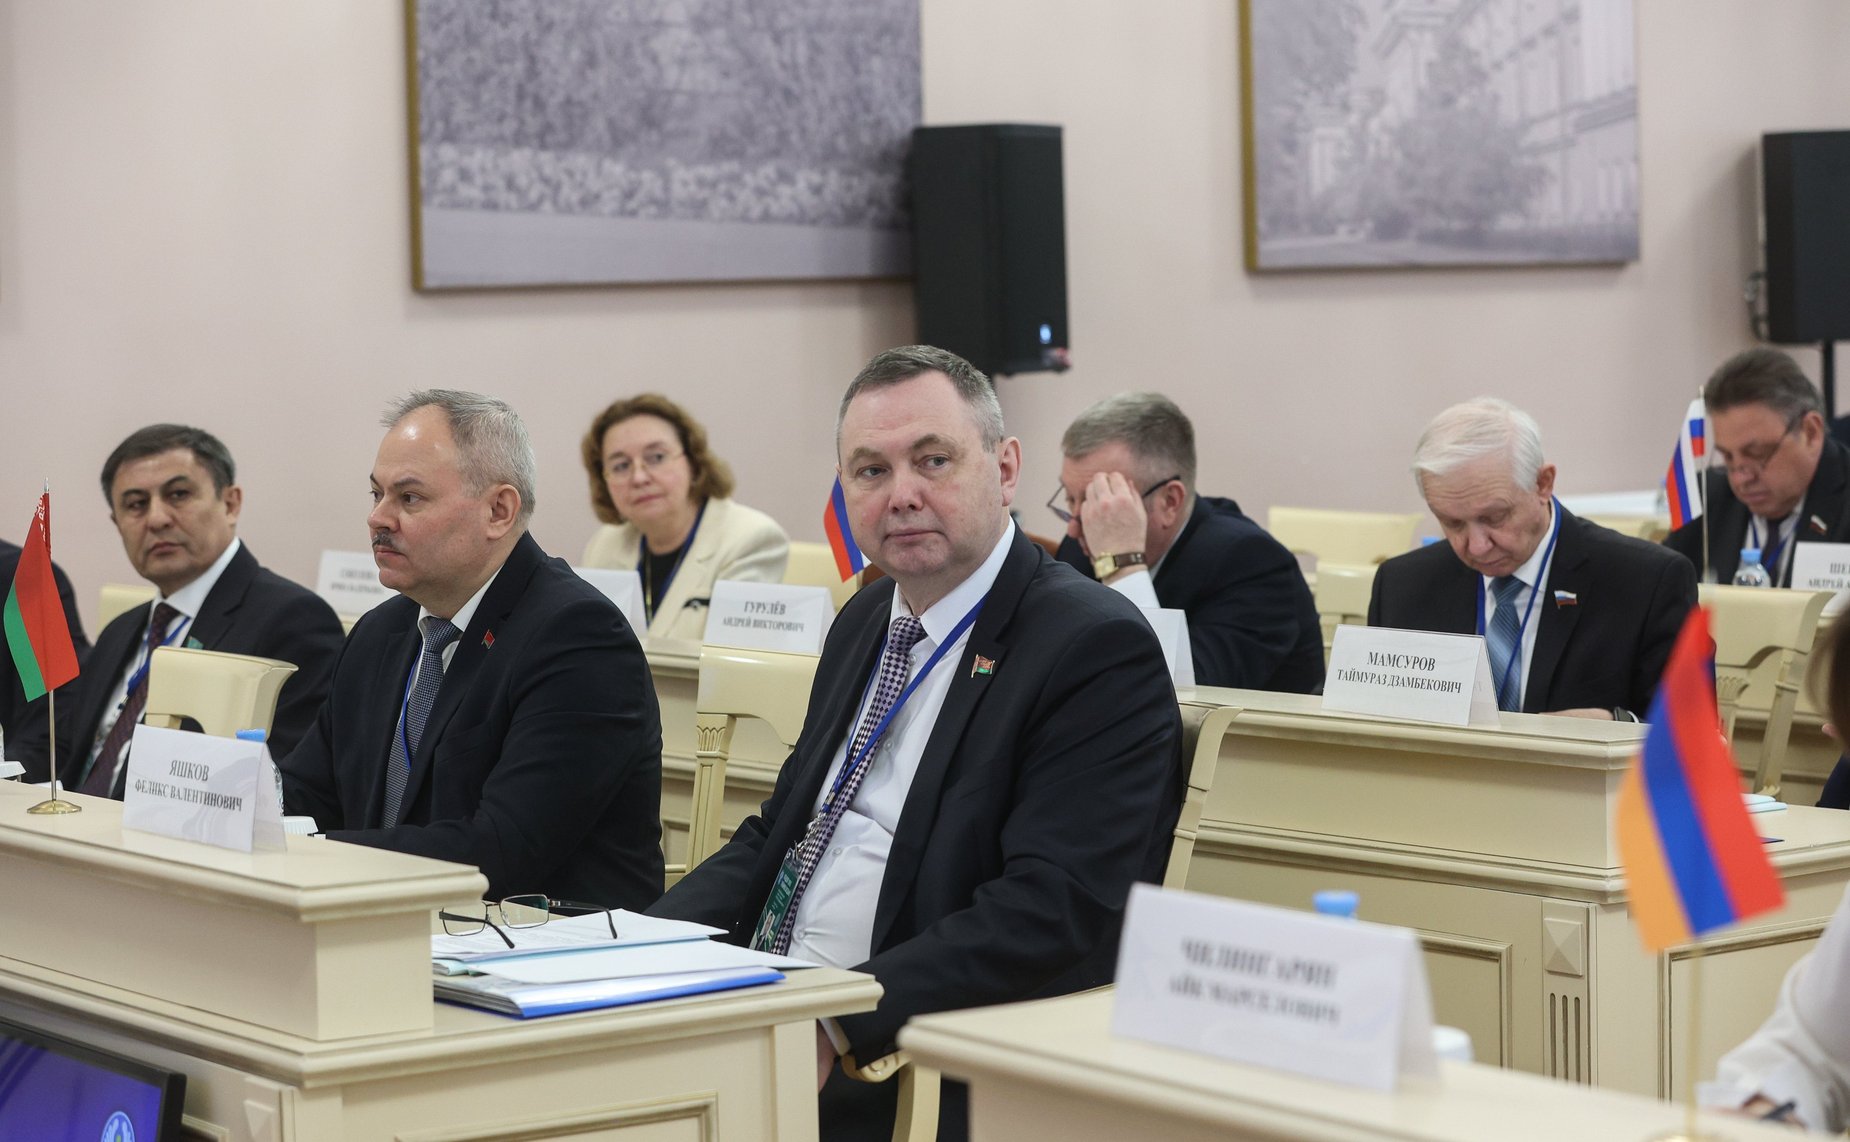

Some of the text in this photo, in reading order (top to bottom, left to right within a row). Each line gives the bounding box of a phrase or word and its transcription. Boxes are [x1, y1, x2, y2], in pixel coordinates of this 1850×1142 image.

[744, 600, 787, 615] ГУРУЛЁВ
[722, 616, 804, 632] АНДРЕЙ ВИКТОРОВИЧ
[1367, 651, 1436, 671] МАМСУРОВ
[1337, 668, 1462, 694] ТАЙМУРАЗ ДЗАМБЕКОВИЧ
[169, 760, 210, 781] ЯШКОВ
[135, 779, 243, 812] ФЕЛИКС ВАЛЕНТИНОВИЧ
